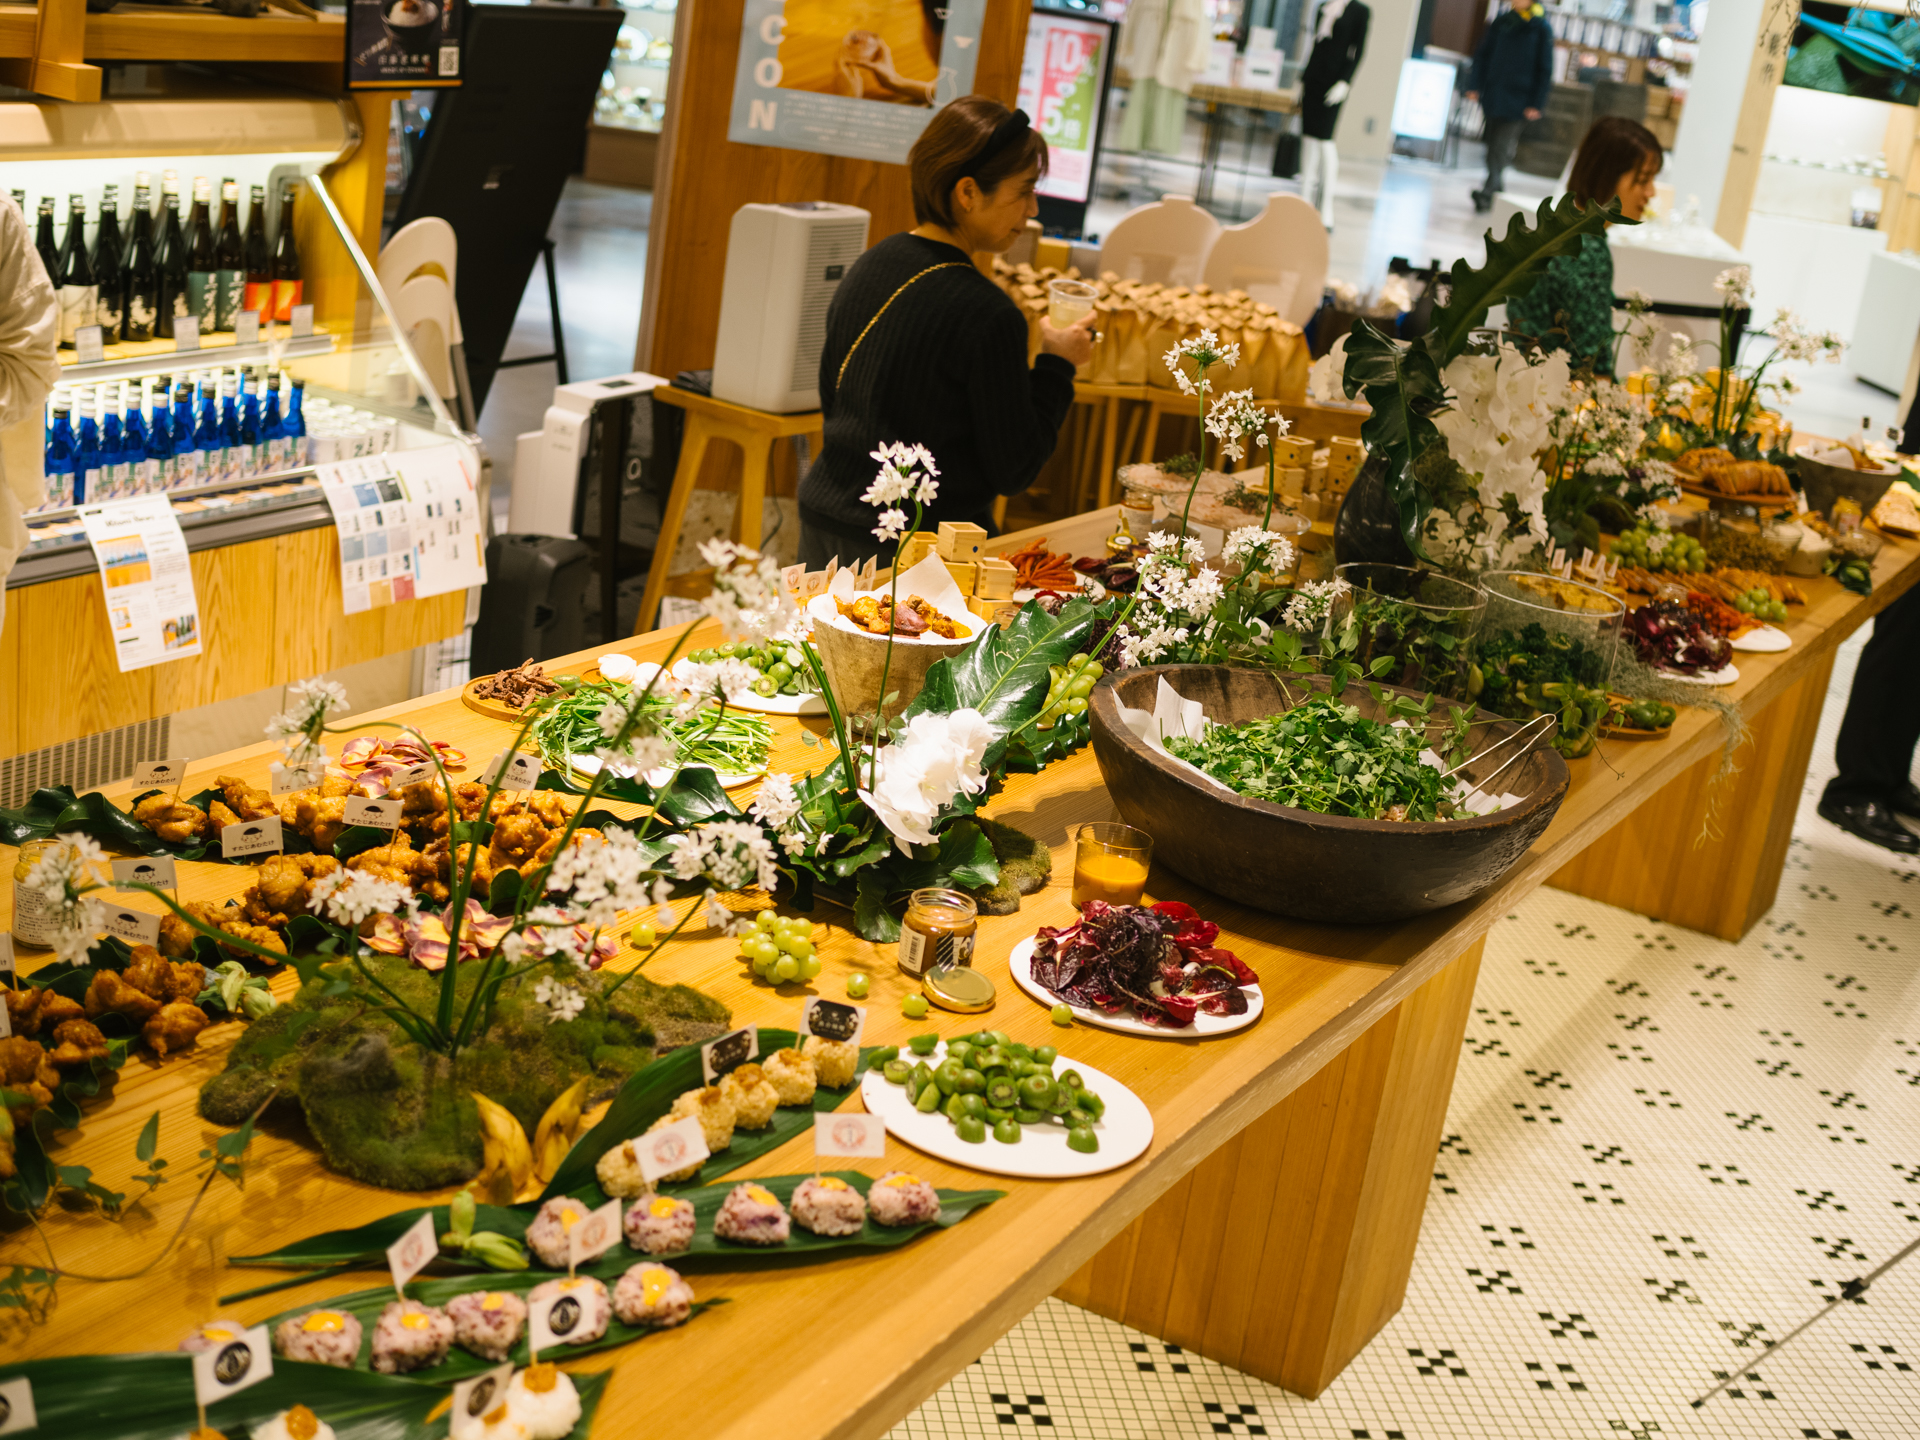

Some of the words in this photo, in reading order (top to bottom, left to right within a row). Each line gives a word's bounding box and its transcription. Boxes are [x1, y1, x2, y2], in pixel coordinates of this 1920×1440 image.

[505, 774, 532, 786] たじあむたけ
[351, 818, 391, 827] すたじあむたけ
[232, 840, 274, 851] すたじあむたけ
[104, 925, 149, 940] すたじあむたけ
